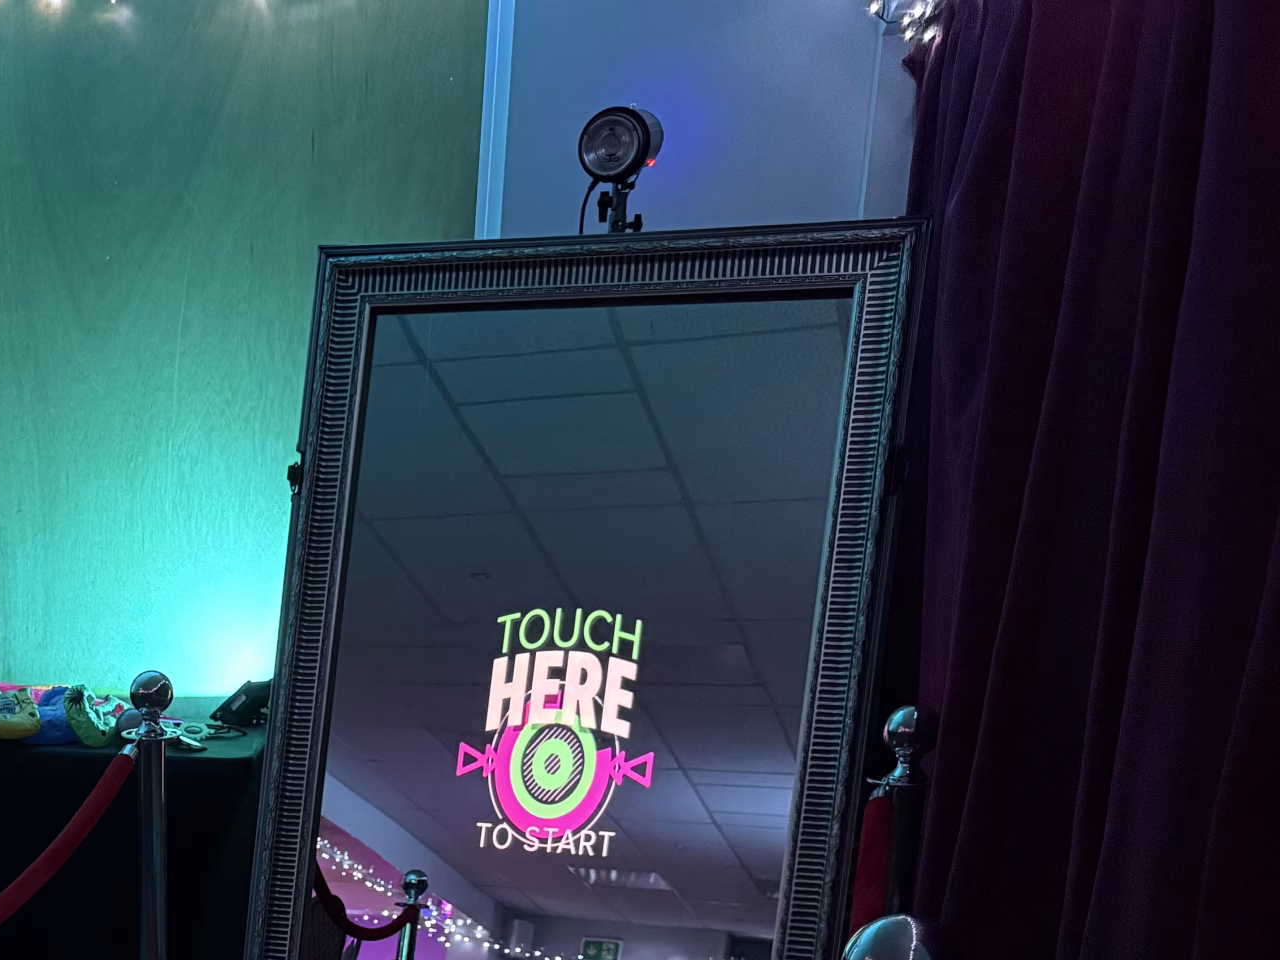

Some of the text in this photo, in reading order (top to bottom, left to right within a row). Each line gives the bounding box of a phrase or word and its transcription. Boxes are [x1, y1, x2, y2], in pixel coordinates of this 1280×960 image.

[497, 607, 643, 660] TOUCH
[484, 650, 639, 739] HERE
[476, 822, 616, 857] TO START
